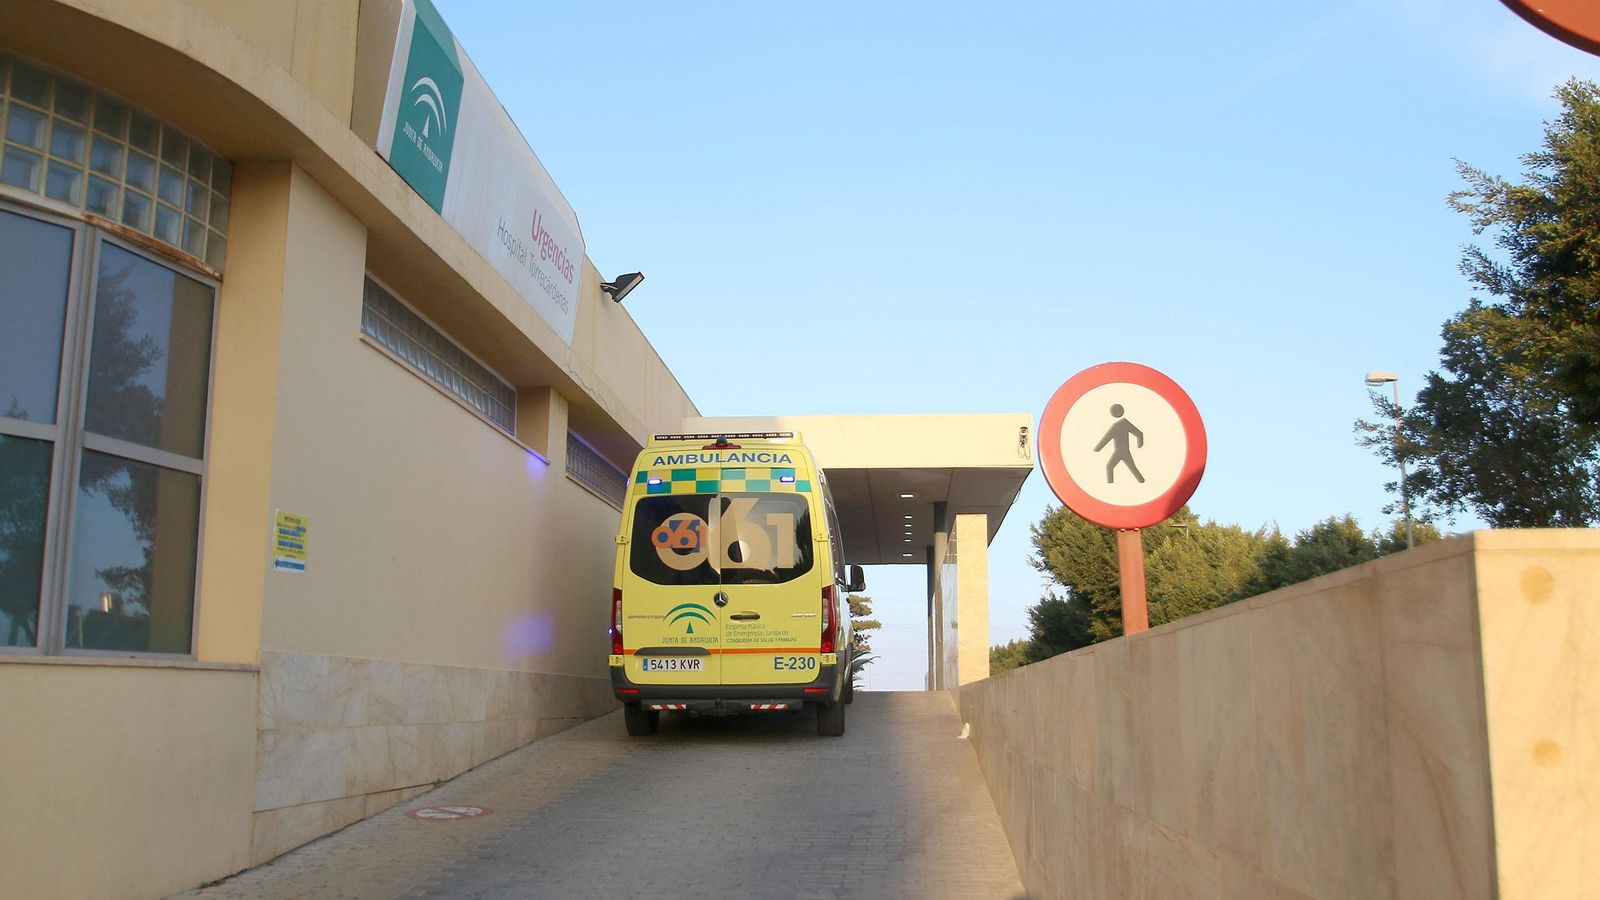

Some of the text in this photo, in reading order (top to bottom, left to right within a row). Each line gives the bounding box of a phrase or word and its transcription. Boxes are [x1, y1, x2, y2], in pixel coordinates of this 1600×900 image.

[497, 217, 528, 267] Hospital
[531, 208, 574, 285] Urgencias
[652, 452, 792, 467] AMBULANCIA
[650, 659, 700, 670] 5413 KVR
[773, 656, 816, 670] E-230
